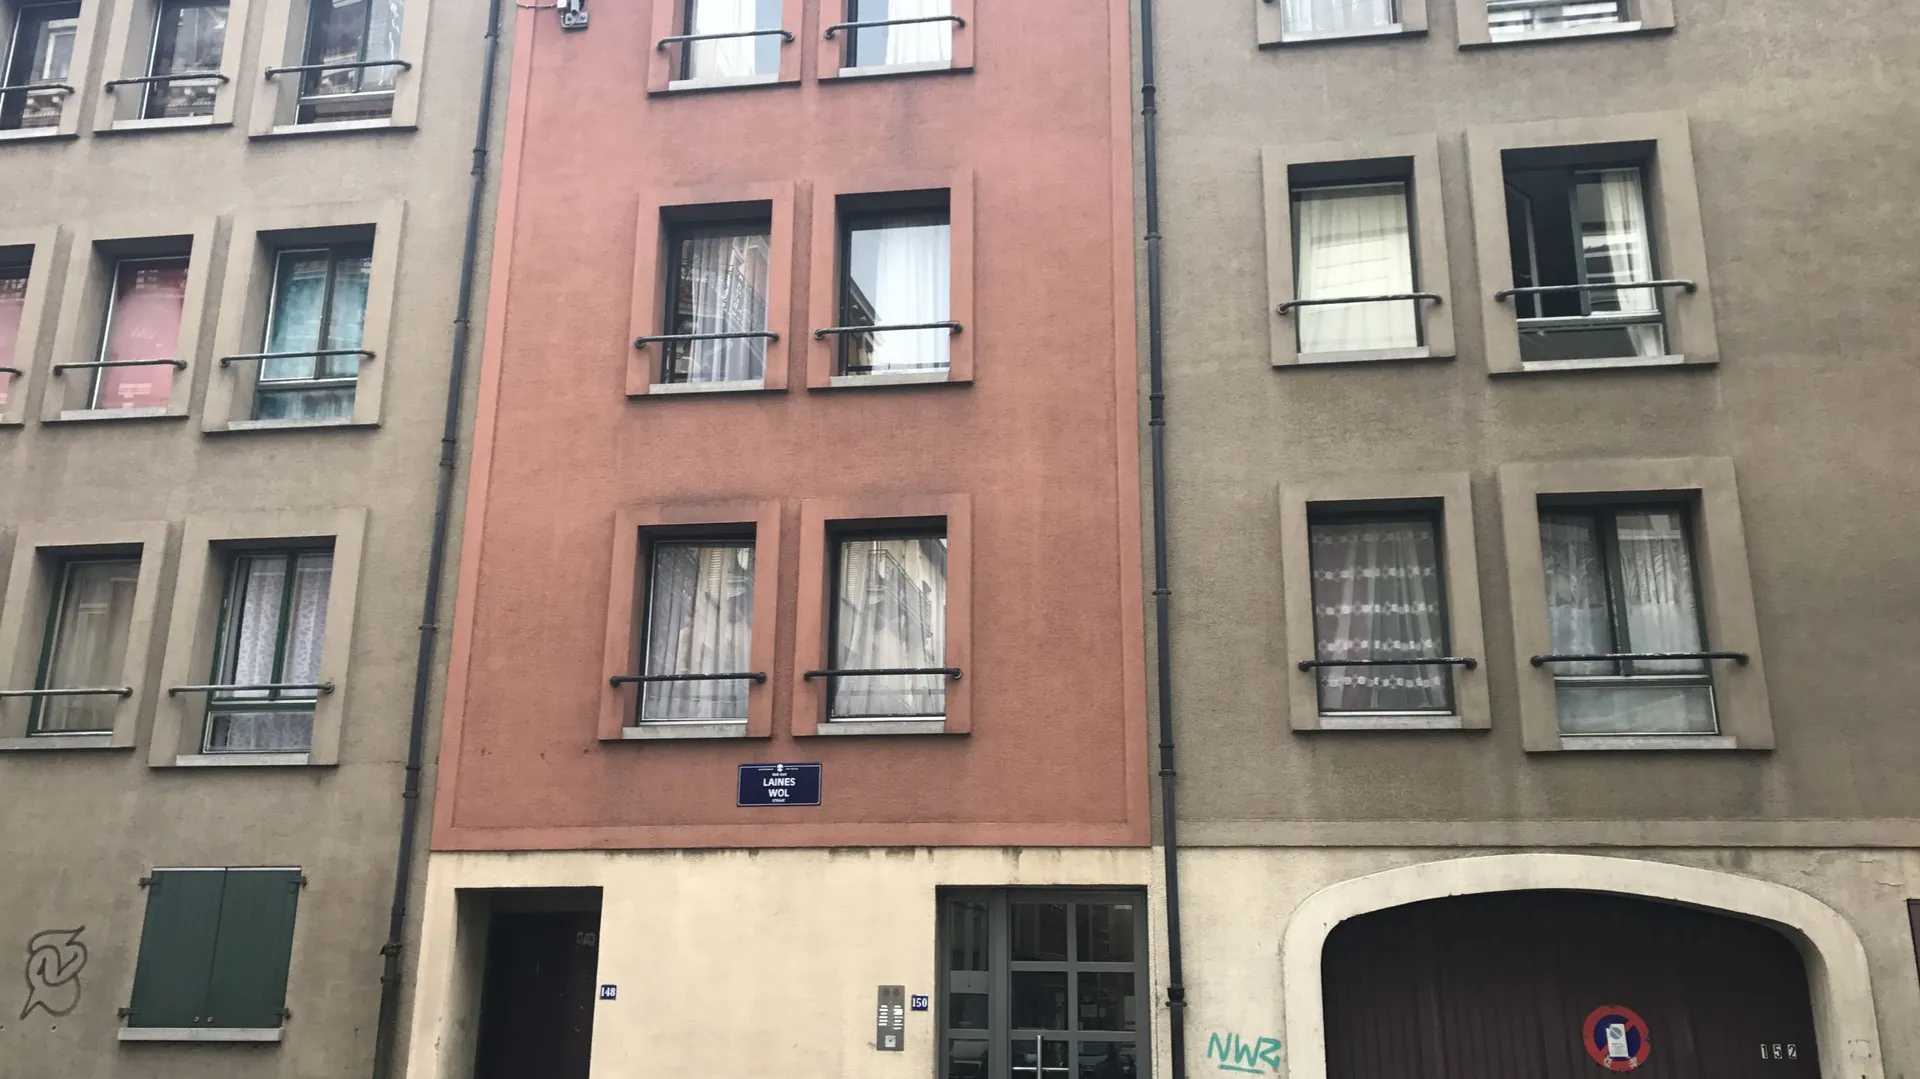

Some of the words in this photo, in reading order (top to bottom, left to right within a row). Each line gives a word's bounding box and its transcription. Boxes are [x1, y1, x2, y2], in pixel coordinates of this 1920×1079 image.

[763, 778, 796, 786] LAINES
[768, 788, 790, 797] WOL
[601, 987, 616, 997] 148
[912, 998, 928, 1008] 150
[1760, 1043, 1798, 1060] 152
